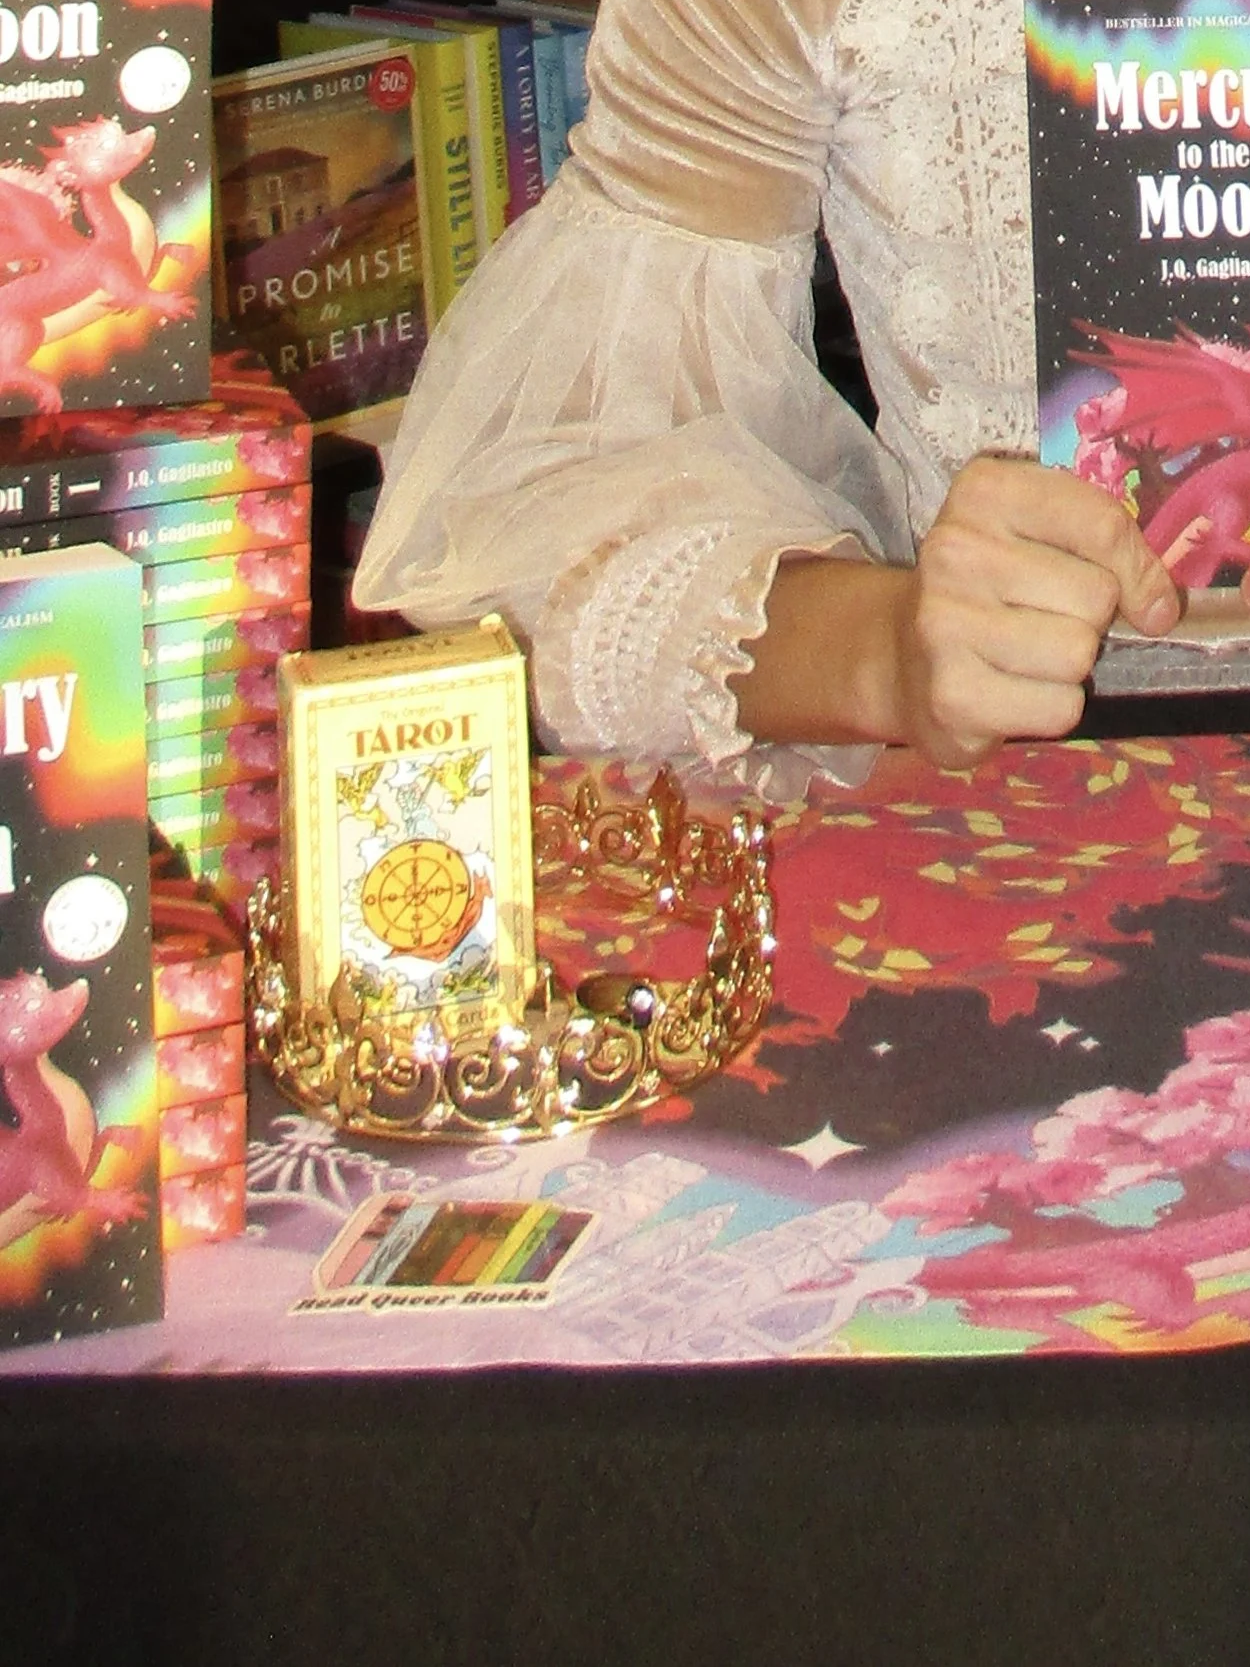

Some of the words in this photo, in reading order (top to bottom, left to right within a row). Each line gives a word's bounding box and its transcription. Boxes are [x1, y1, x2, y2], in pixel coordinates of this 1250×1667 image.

[1106, 15, 1184, 30] BESTSELLER
[1187, 15, 1202, 27] IN
[224, 85, 306, 118] SERENA
[1178, 140, 1203, 168] to
[1211, 139, 1249, 167] the
[239, 244, 414, 315] PROMISE
[348, 714, 477, 758] TAROT
